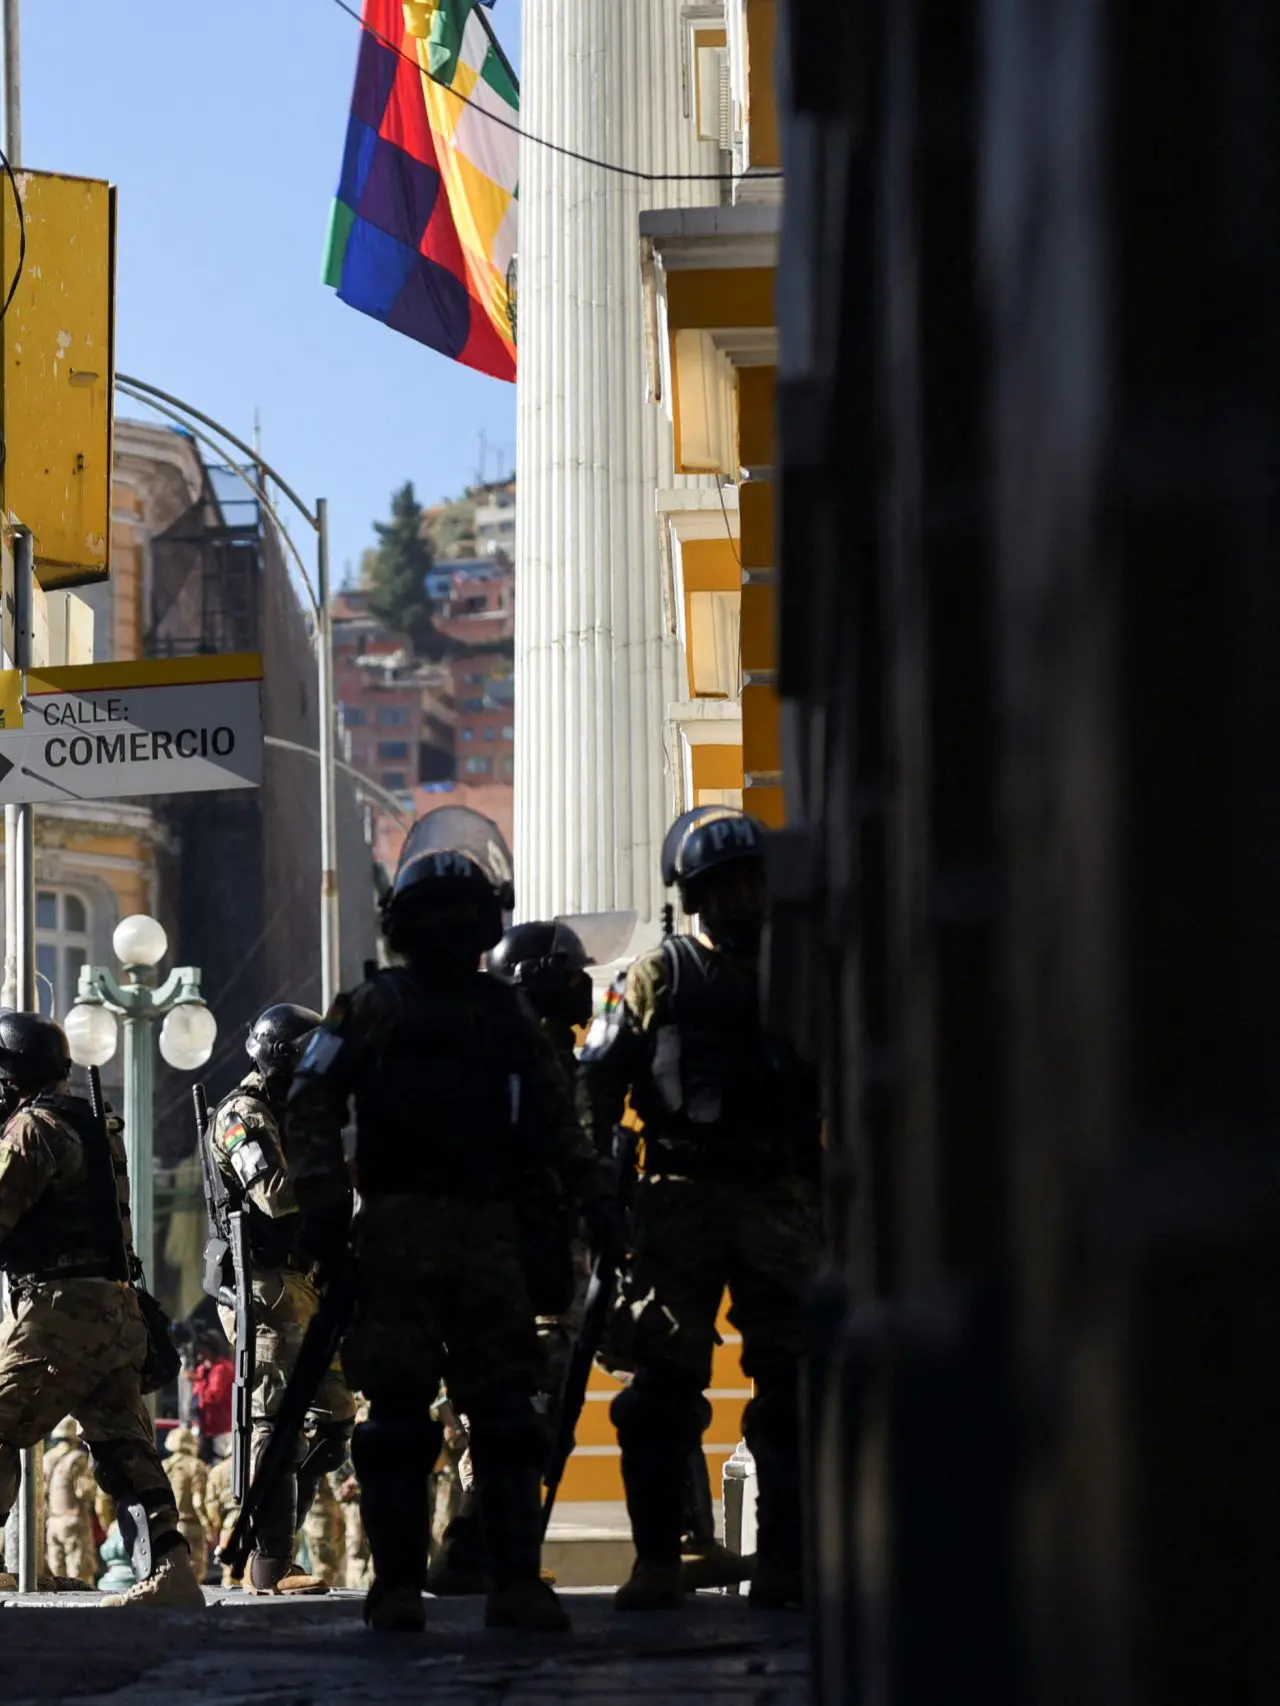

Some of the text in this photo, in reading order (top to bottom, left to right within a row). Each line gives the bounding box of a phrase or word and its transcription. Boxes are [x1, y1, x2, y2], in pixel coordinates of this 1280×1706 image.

[43, 698, 129, 727] CALLE:
[44, 726, 236, 768] COMERCIO
[708, 818, 755, 851] PM
